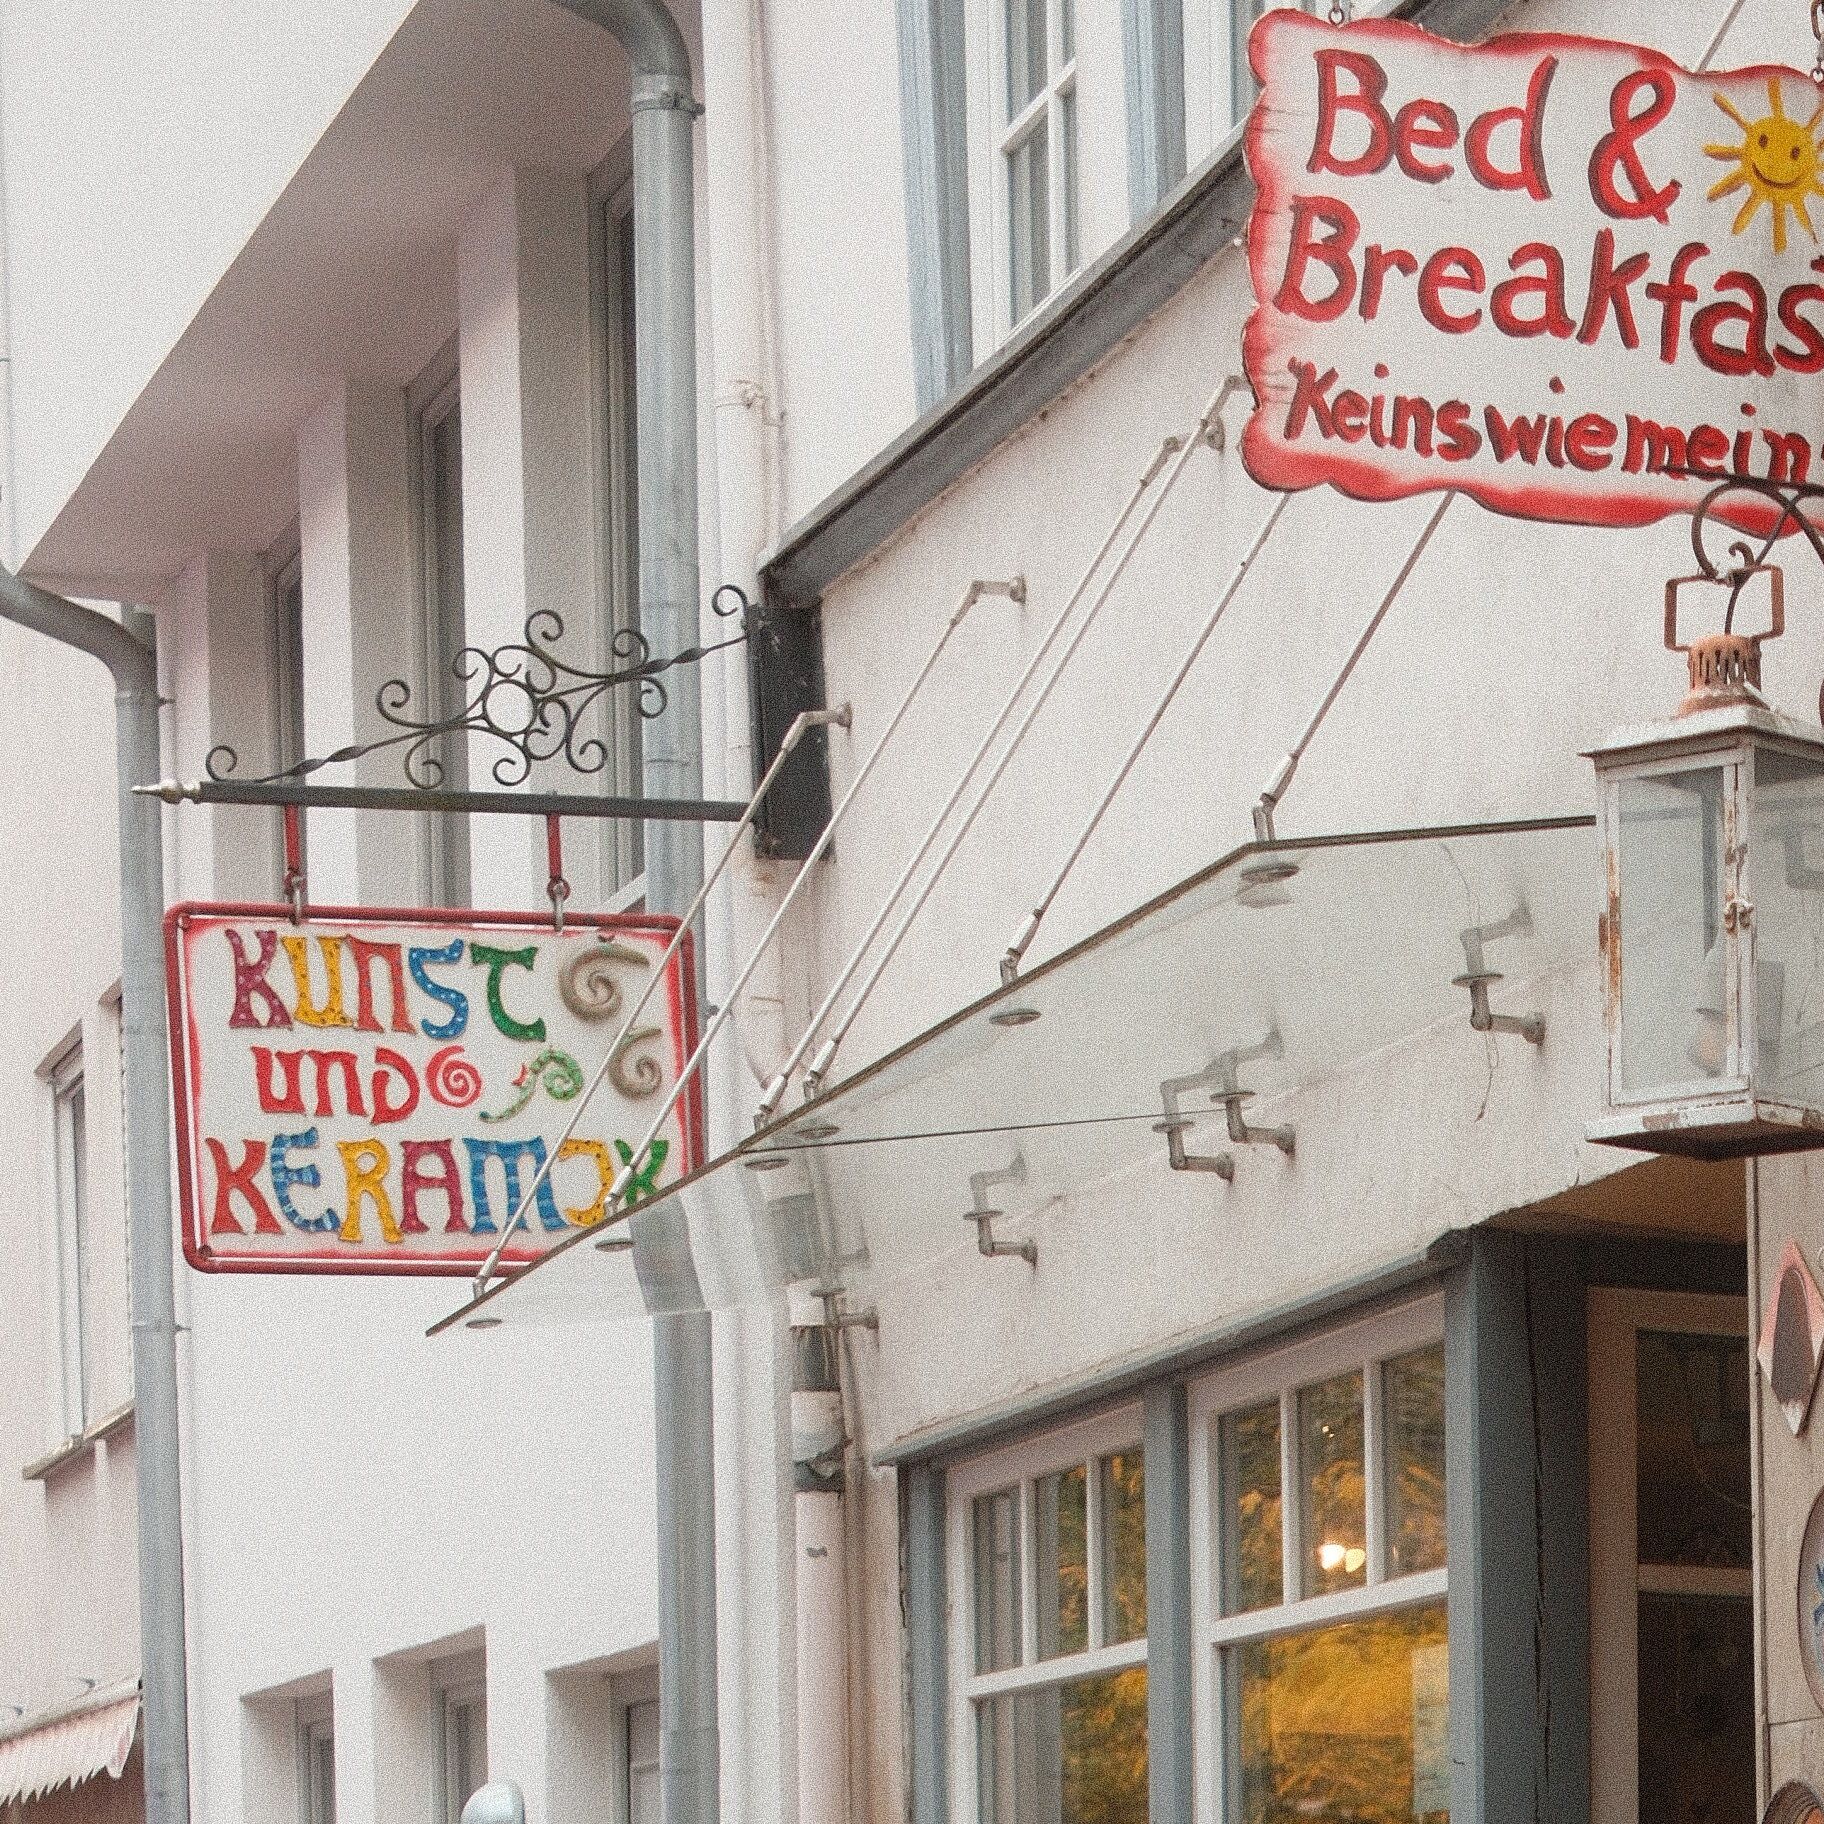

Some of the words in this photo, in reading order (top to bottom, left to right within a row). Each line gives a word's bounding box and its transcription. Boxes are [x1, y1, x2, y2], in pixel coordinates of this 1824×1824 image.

[1307, 50, 1557, 200] Bed
[1588, 69, 1680, 224] &
[1284, 358, 1481, 461] Keins
[1485, 378, 1619, 473] wie
[226, 928, 546, 1042] KUNST
